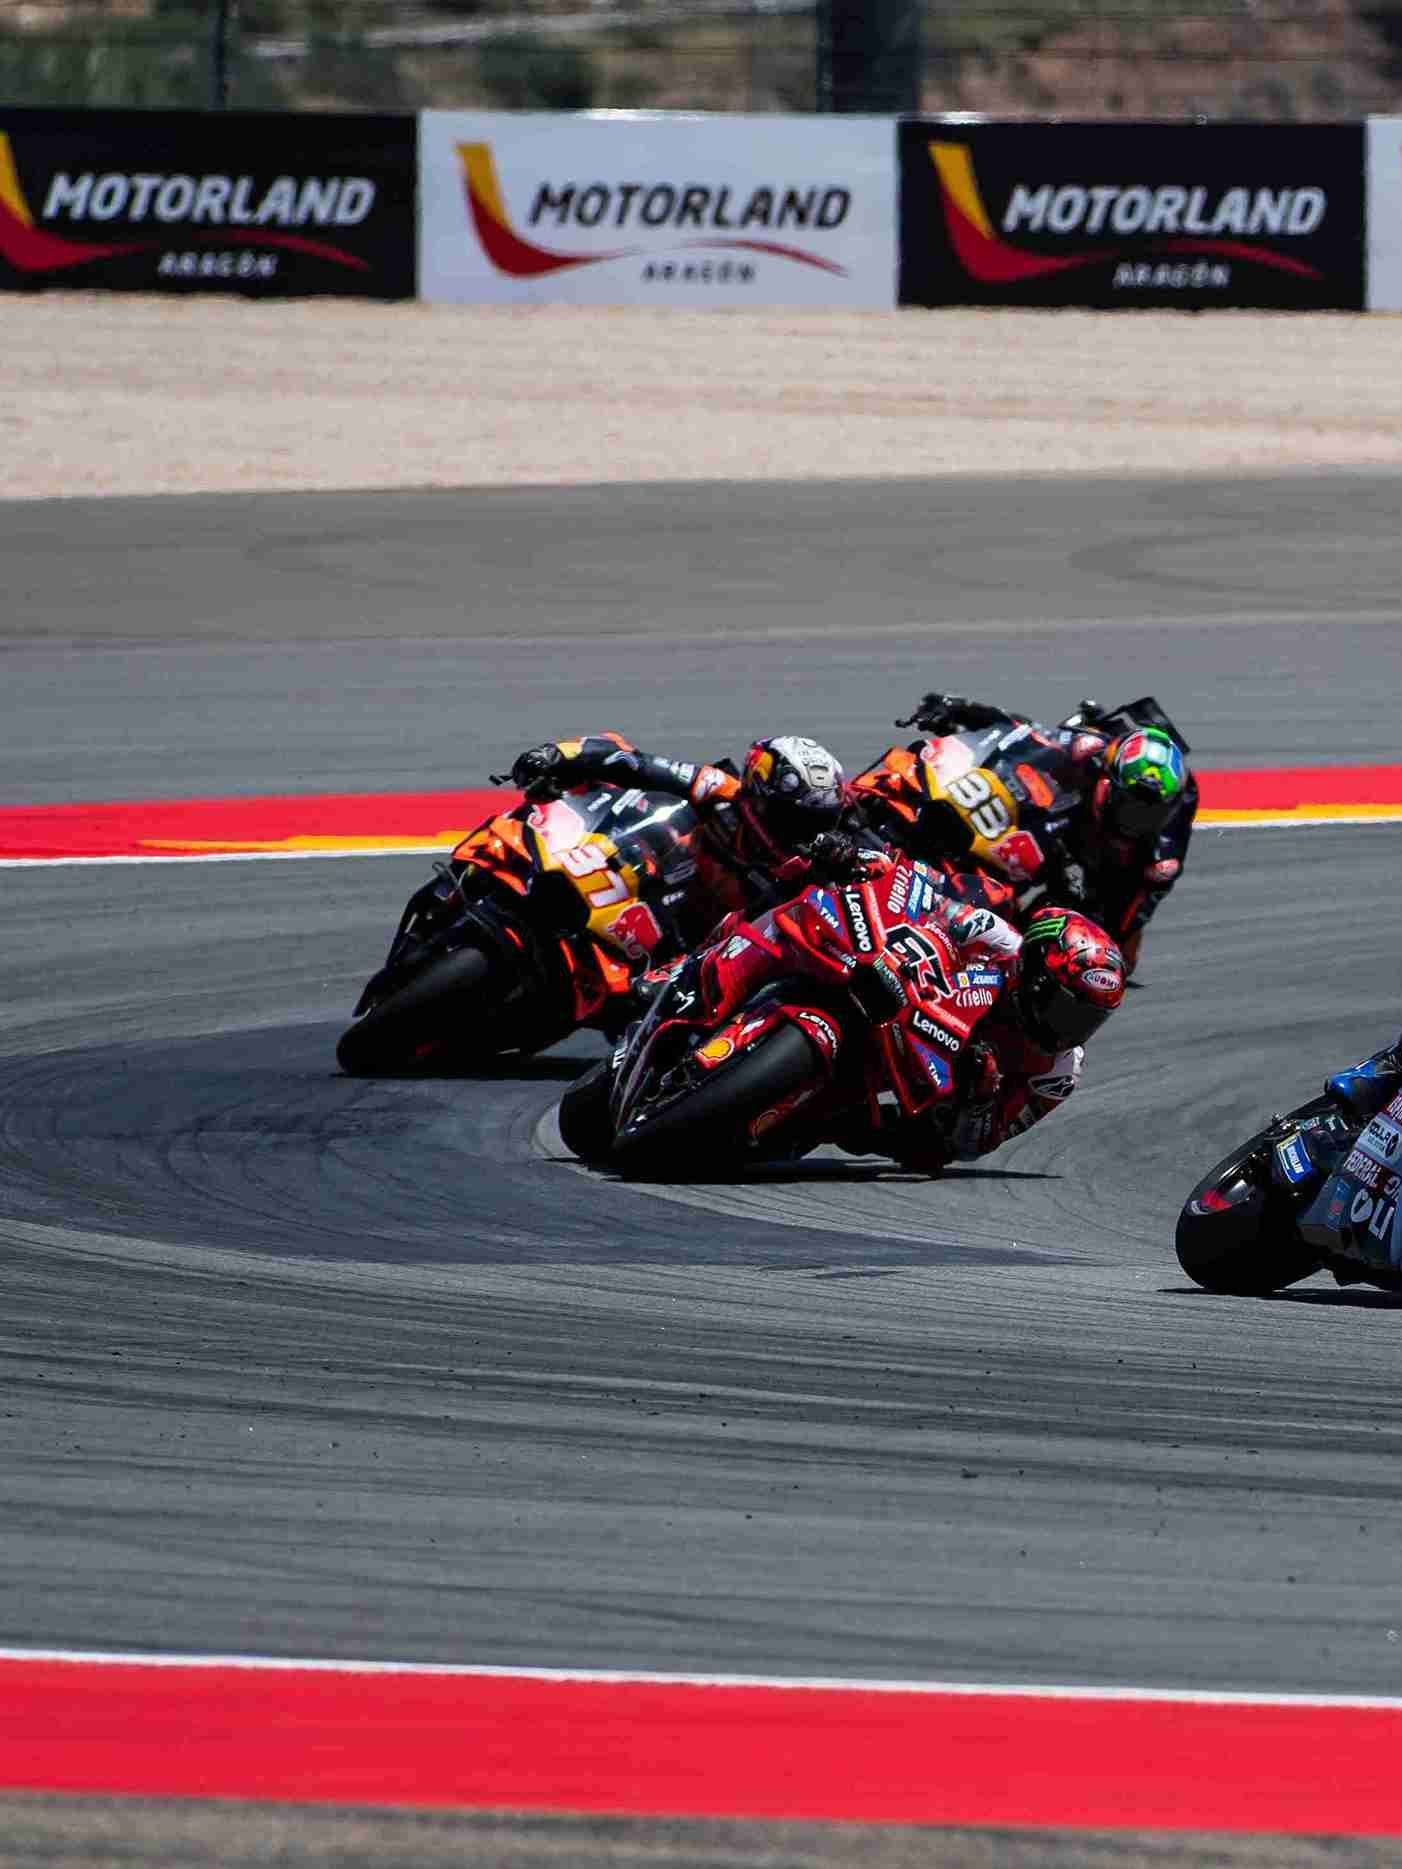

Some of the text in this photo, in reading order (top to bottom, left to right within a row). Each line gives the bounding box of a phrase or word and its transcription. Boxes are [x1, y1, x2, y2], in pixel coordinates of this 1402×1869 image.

[42, 174, 376, 225] MOTORLAND
[527, 182, 853, 230] MOTORLAND
[1003, 185, 1326, 236] MOTORLAND
[947, 772, 1009, 840] 33
[819, 906, 840, 929] TIM
[845, 891, 873, 952] Lenovo
[912, 1009, 961, 1052] Lenovo
[928, 1061, 943, 1087] TIM
